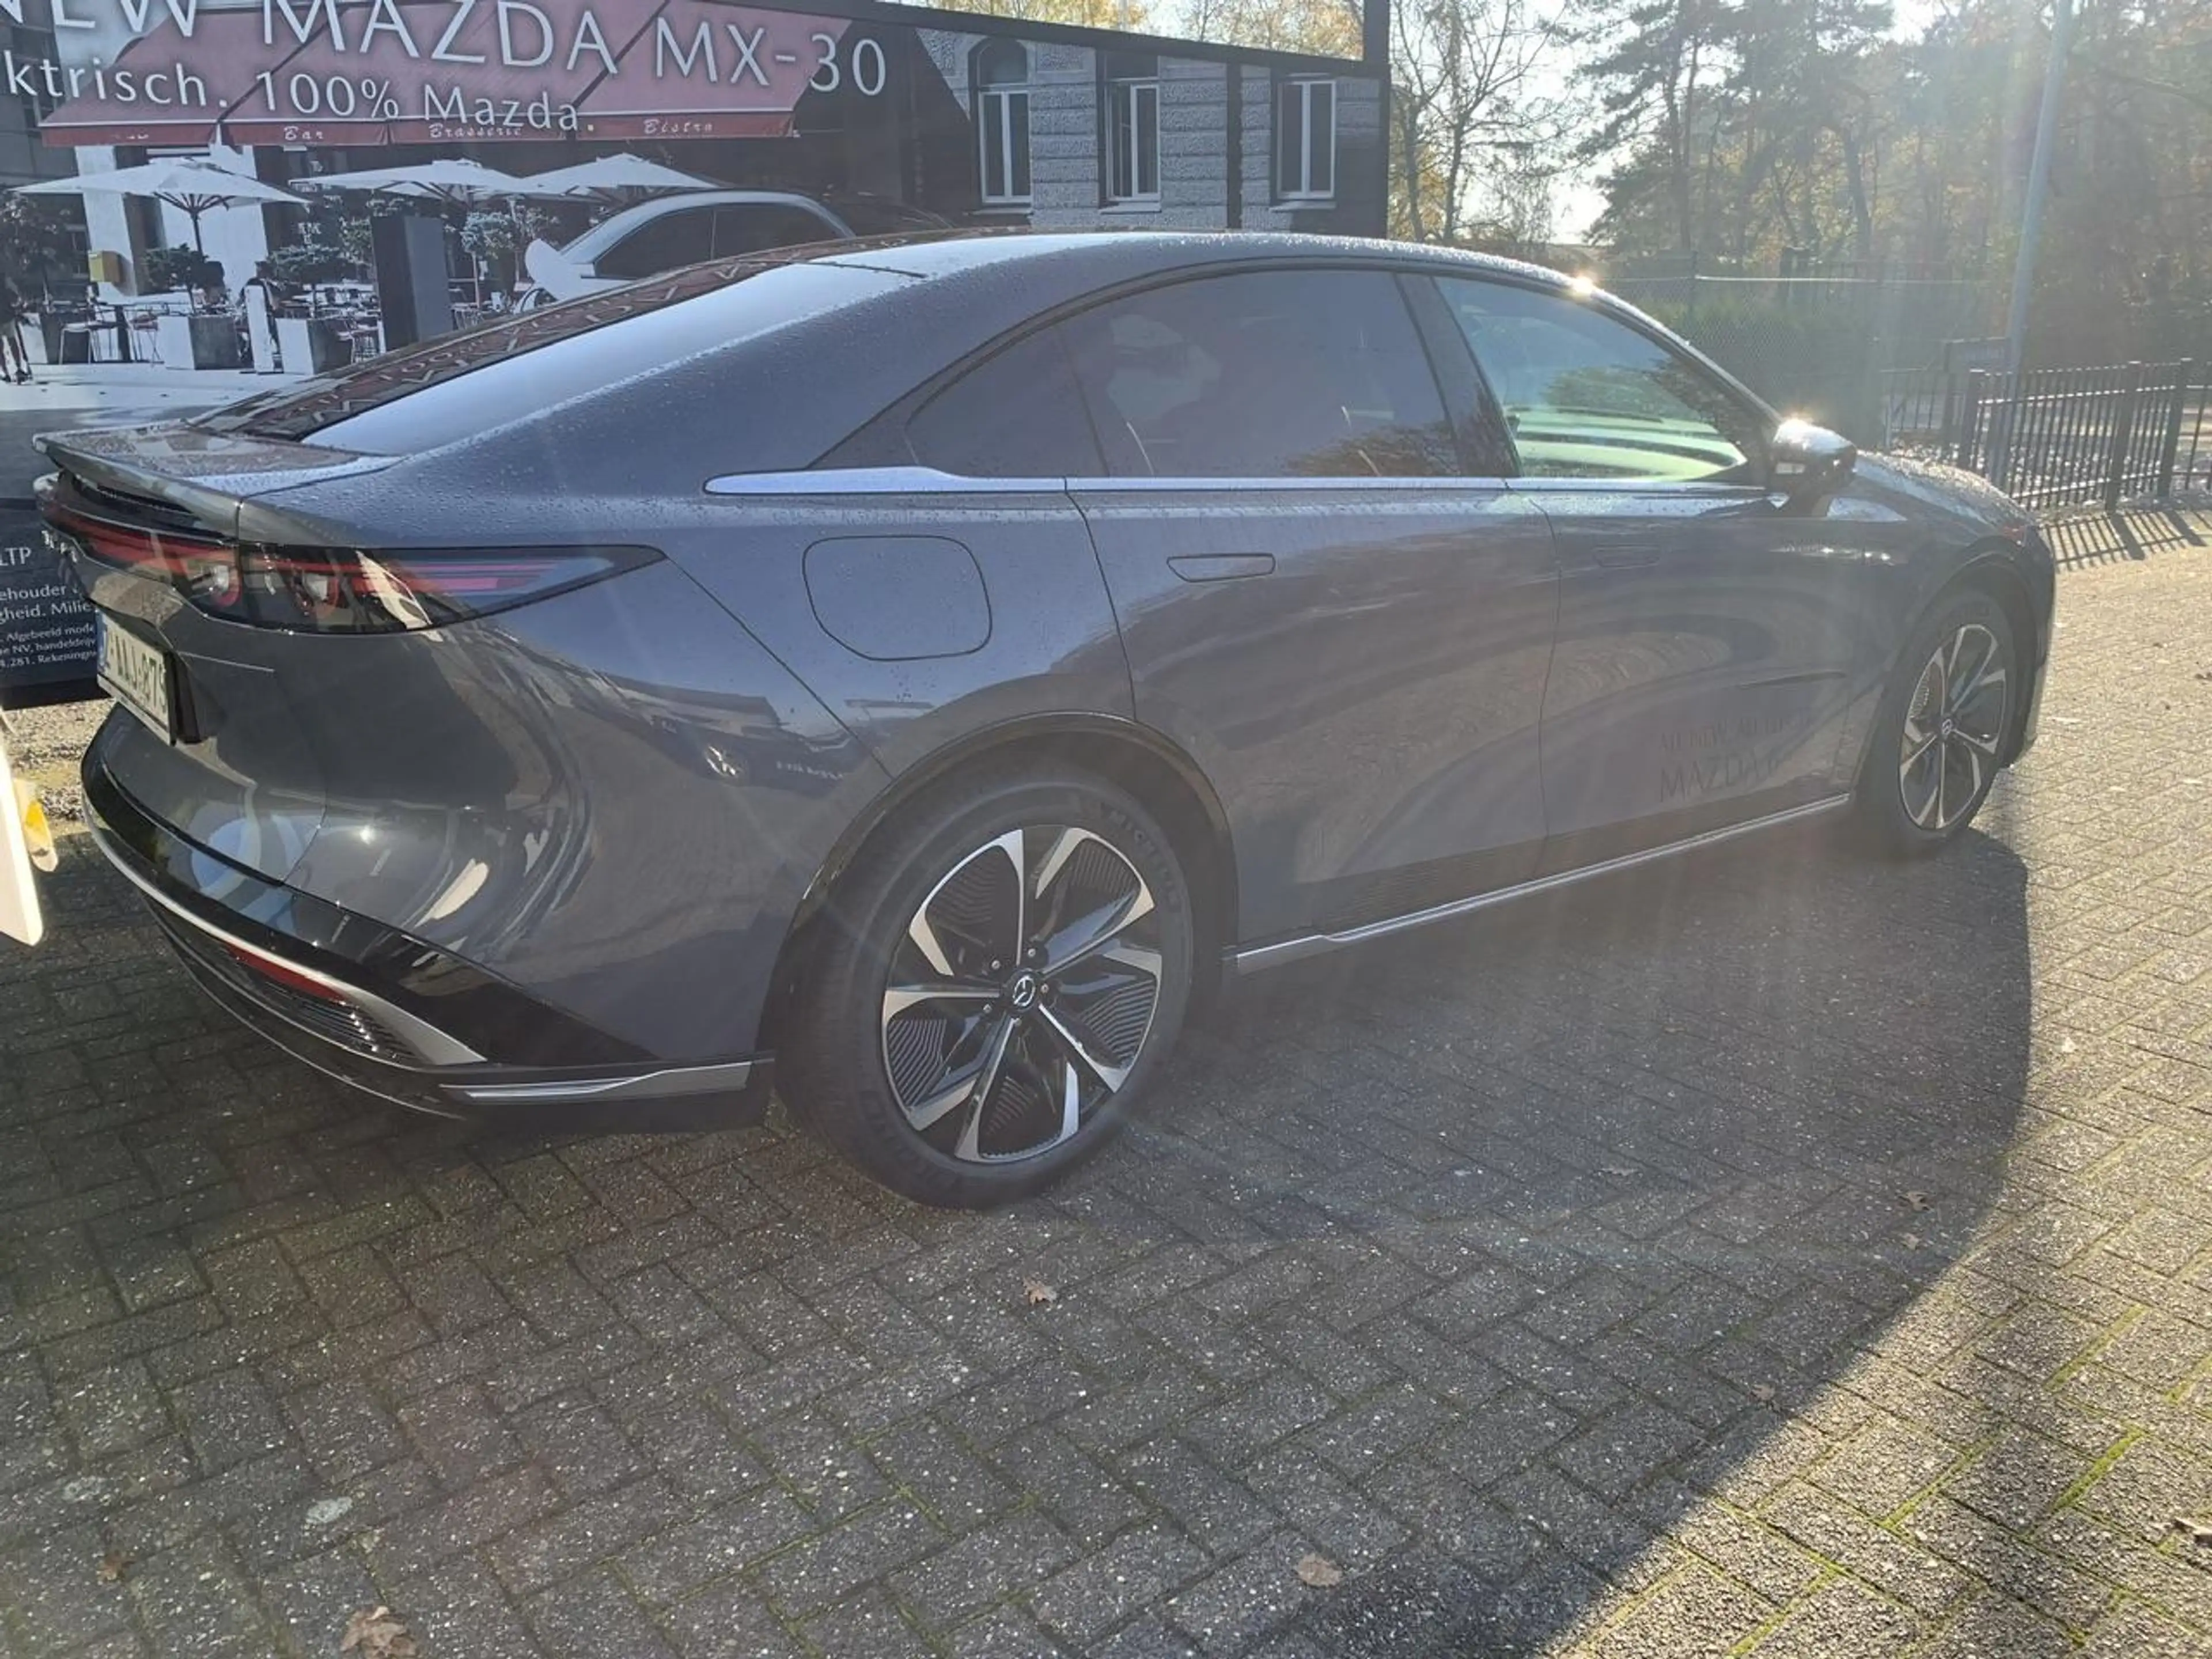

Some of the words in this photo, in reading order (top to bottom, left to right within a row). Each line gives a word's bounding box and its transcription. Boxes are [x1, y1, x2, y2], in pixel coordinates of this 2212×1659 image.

[262, 0, 618, 74] MAZDA
[656, 16, 886, 96] MX-30
[3, 50, 228, 108] ktrisch.
[256, 71, 399, 119] 100%
[424, 84, 594, 132] Mazda.
[283, 126, 324, 141] Bar
